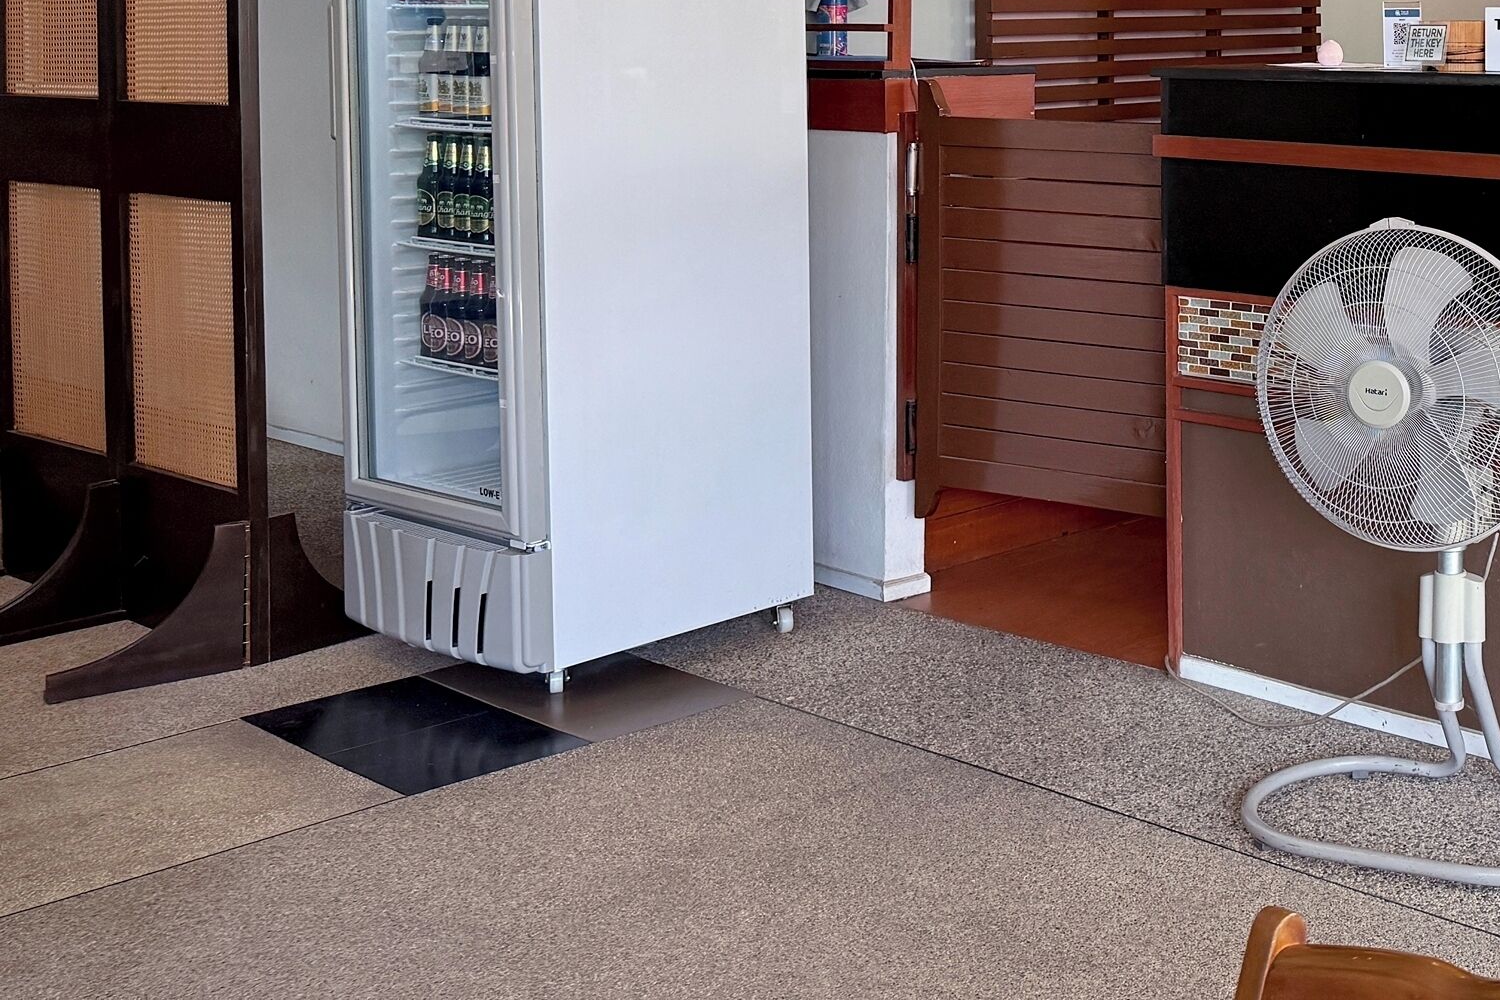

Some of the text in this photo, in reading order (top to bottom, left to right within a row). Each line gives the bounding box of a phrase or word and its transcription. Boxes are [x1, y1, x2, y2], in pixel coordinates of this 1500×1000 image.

[1411, 28, 1443, 38] RETURN
[1410, 38, 1442, 48] THE KEY
[1413, 48, 1434, 58] HERE
[484, 338, 498, 348] EO
[480, 486, 500, 500] LOW-E
